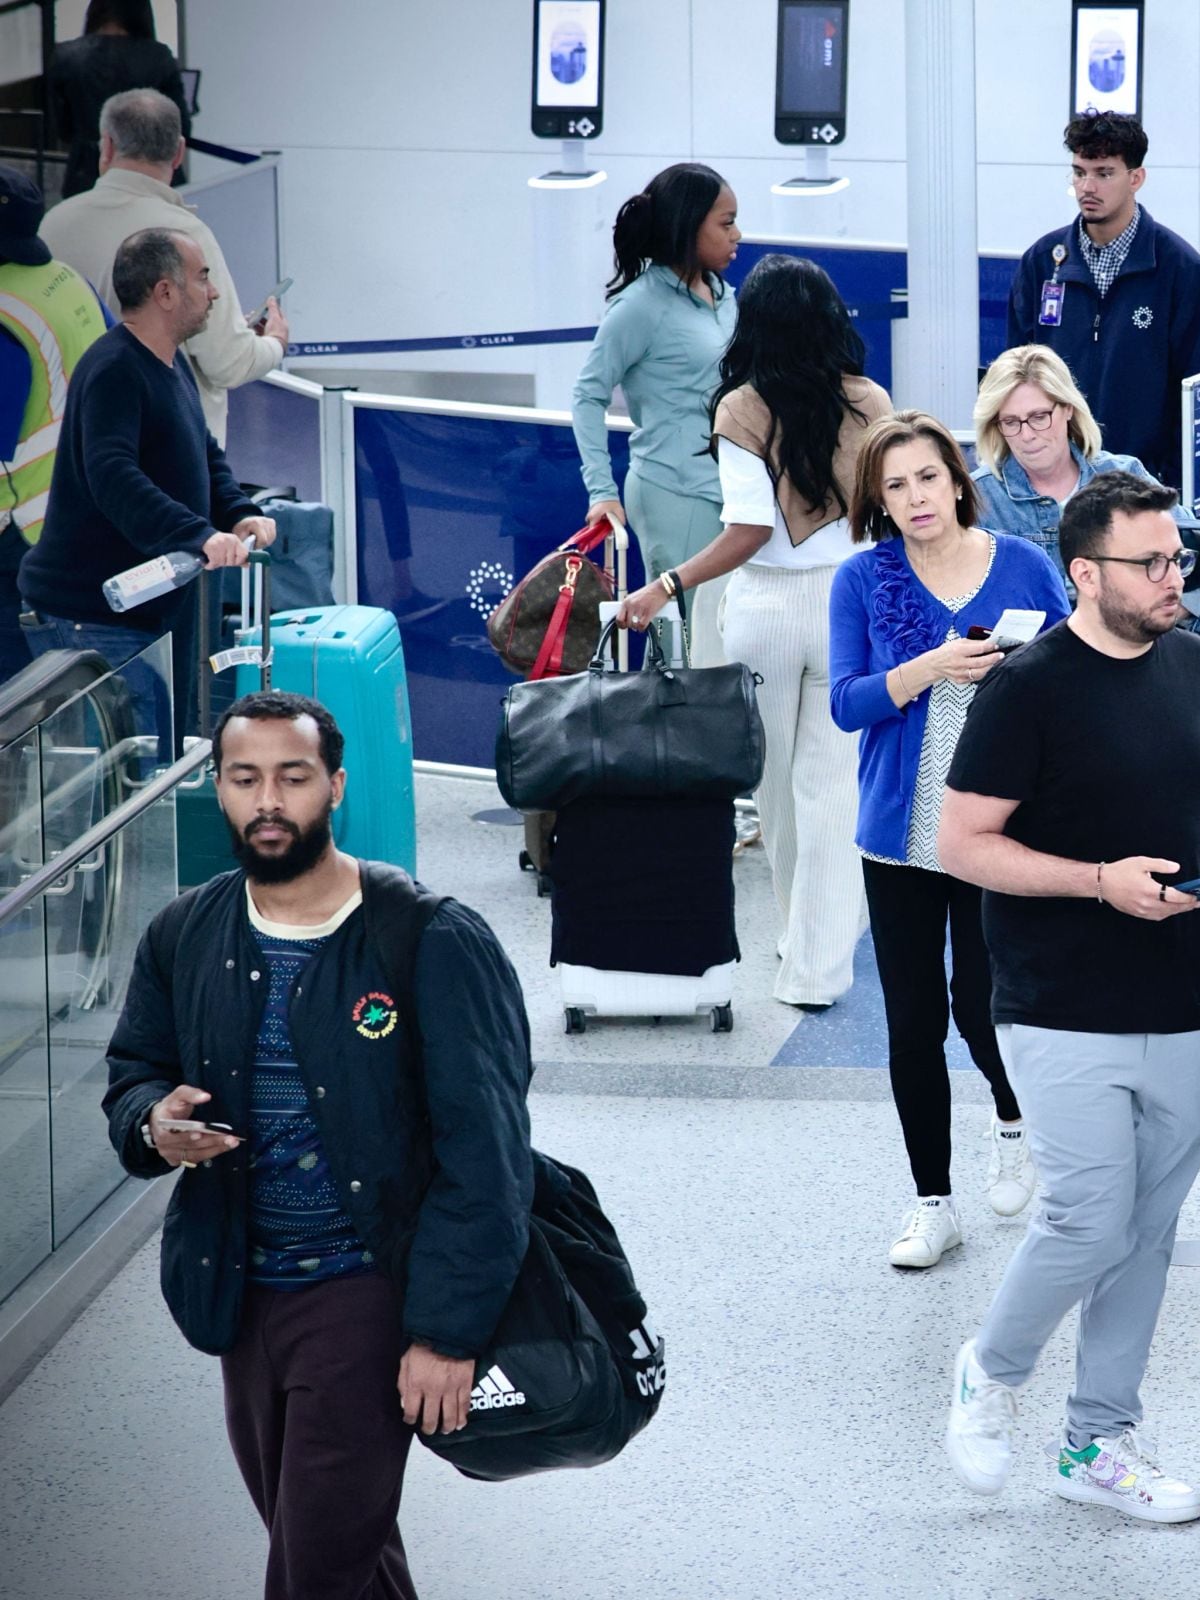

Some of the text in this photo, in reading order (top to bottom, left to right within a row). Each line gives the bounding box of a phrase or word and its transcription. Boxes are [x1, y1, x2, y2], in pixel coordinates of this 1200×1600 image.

[481, 335, 514, 345] CLEAR
[303, 345, 339, 353] CLEAR
[352, 991, 394, 1021] DAILY PAPER
[356, 1024, 380, 1039] DAILY
[468, 1391, 526, 1411] adidas
